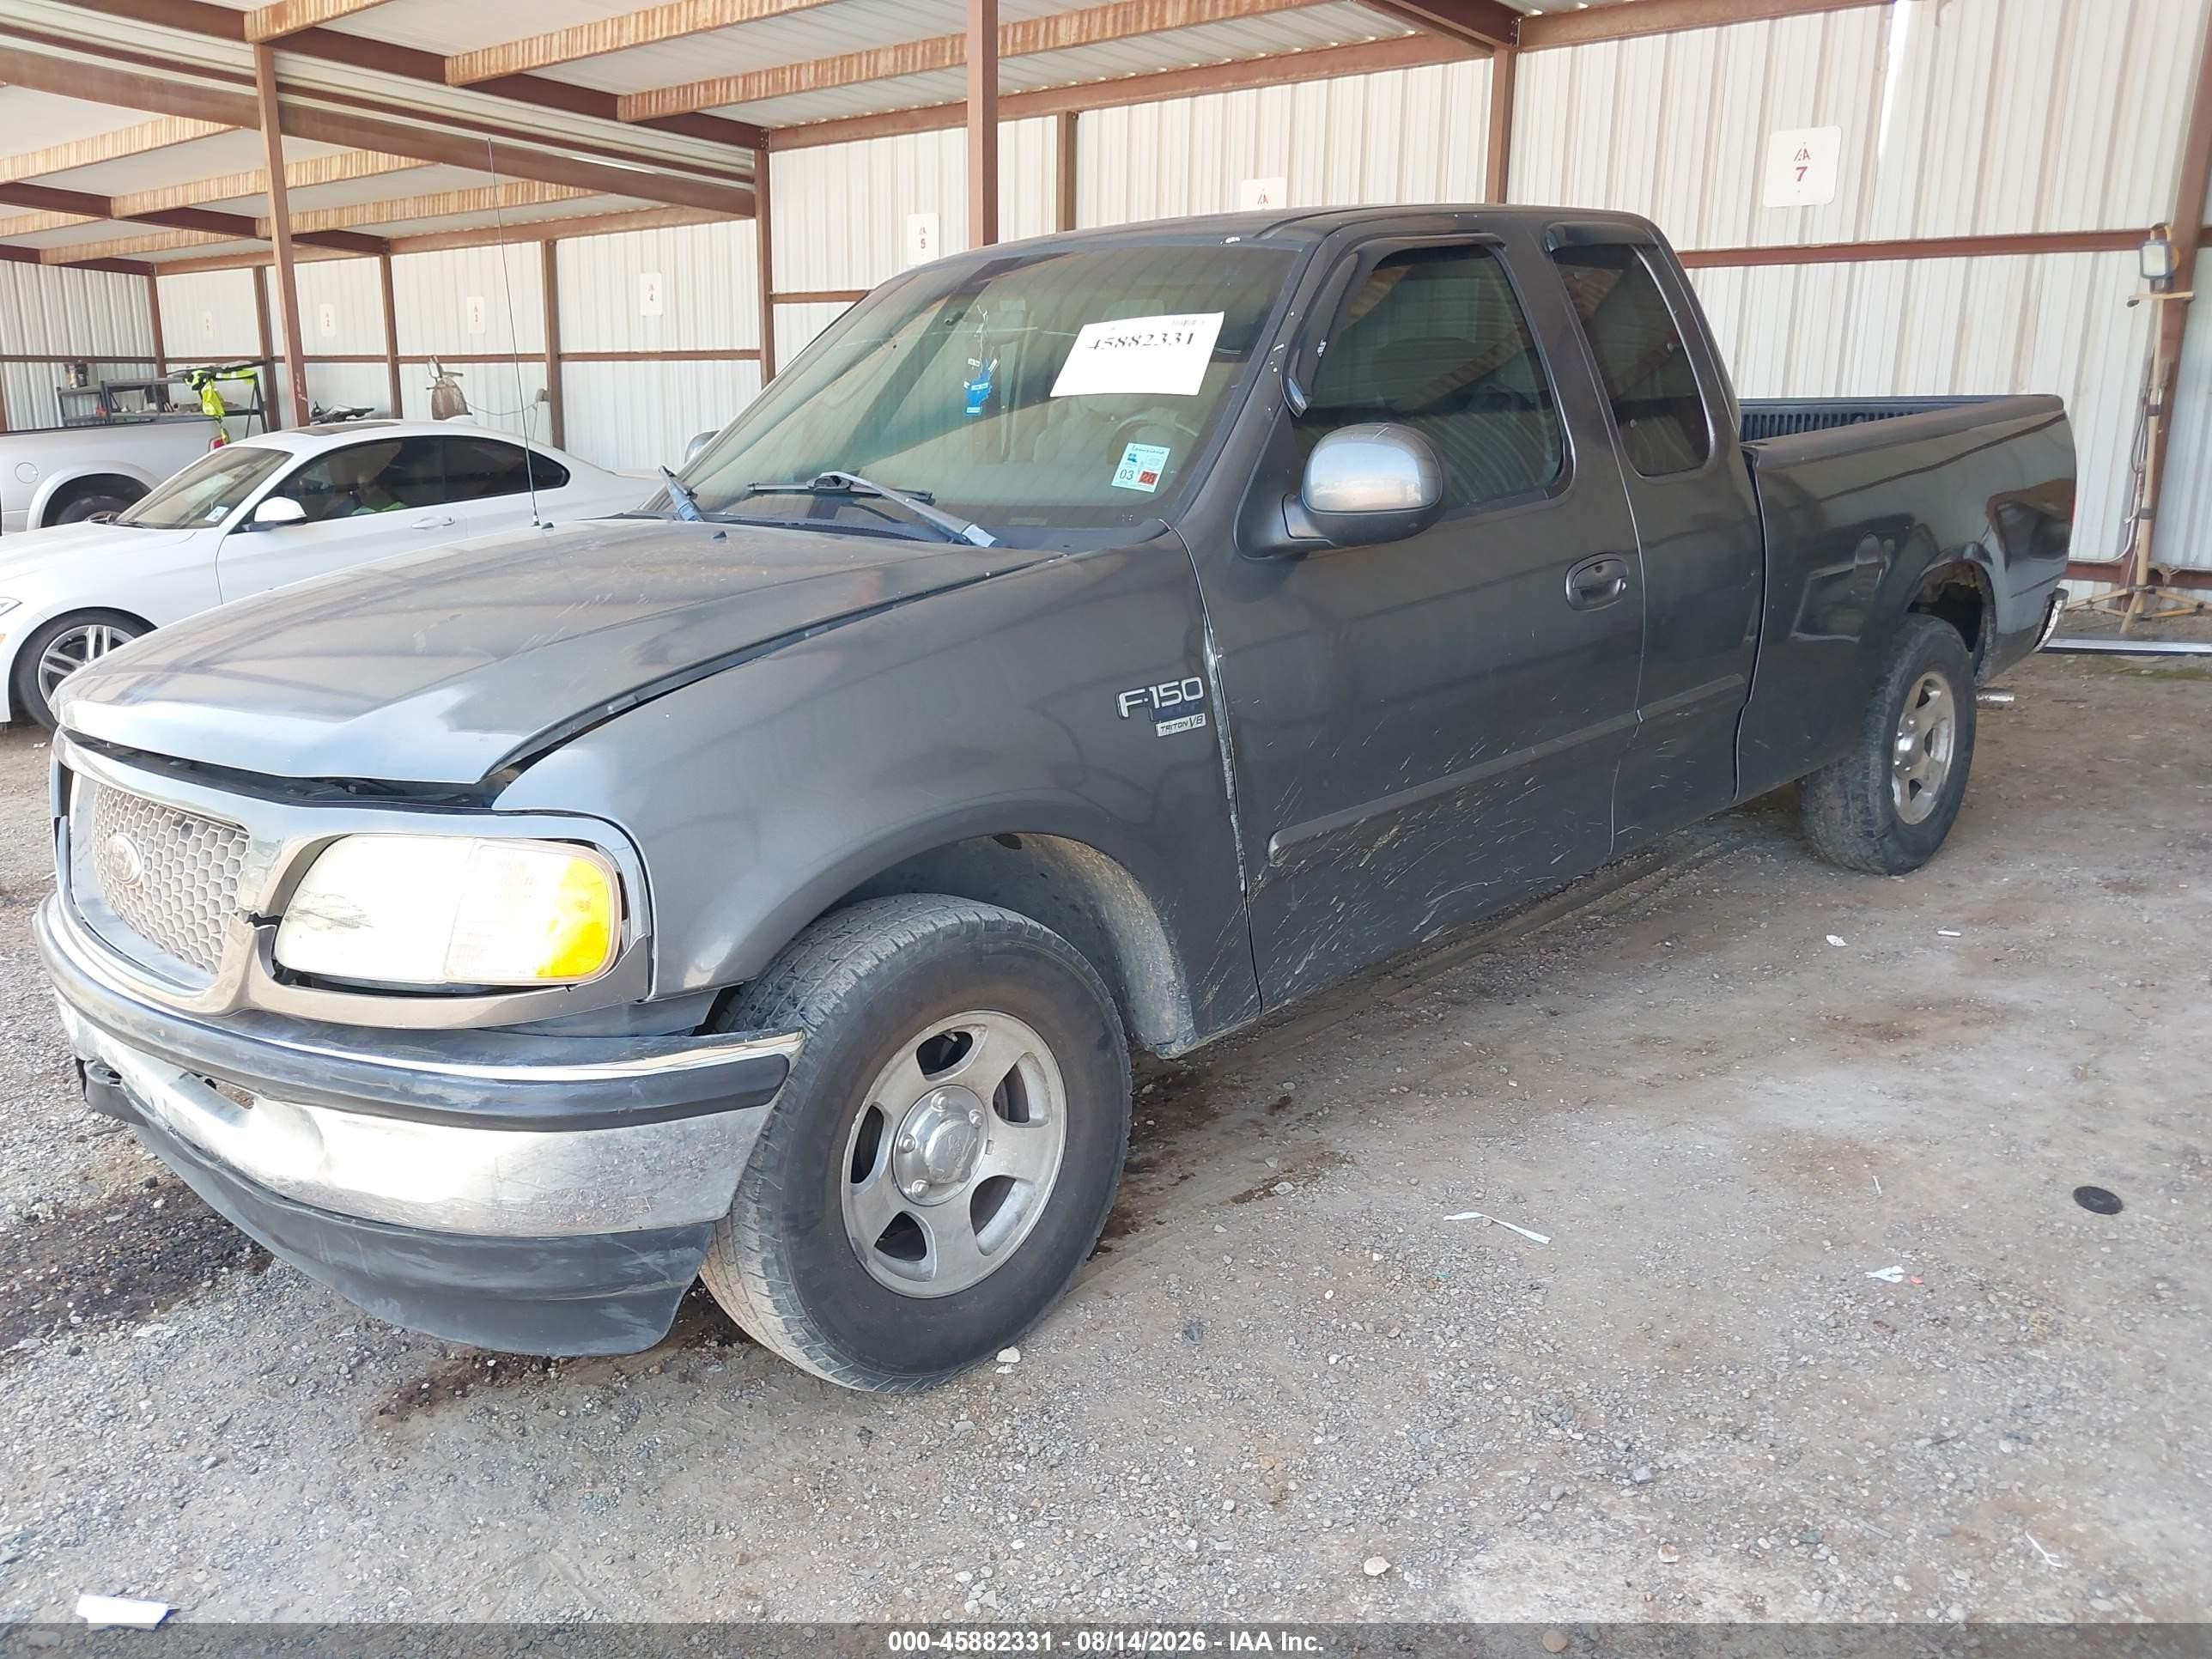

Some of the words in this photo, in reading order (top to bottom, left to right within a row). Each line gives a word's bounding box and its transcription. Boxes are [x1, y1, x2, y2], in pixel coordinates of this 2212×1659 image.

[1796, 166, 1808, 182] 7
[920, 238, 927, 249] 5
[1088, 332, 1194, 350] 45882331
[1119, 469, 1134, 481] 03
[1142, 472, 1155, 483] 28
[1161, 720, 1188, 732] TRITON
[1189, 715, 1203, 727] V8
